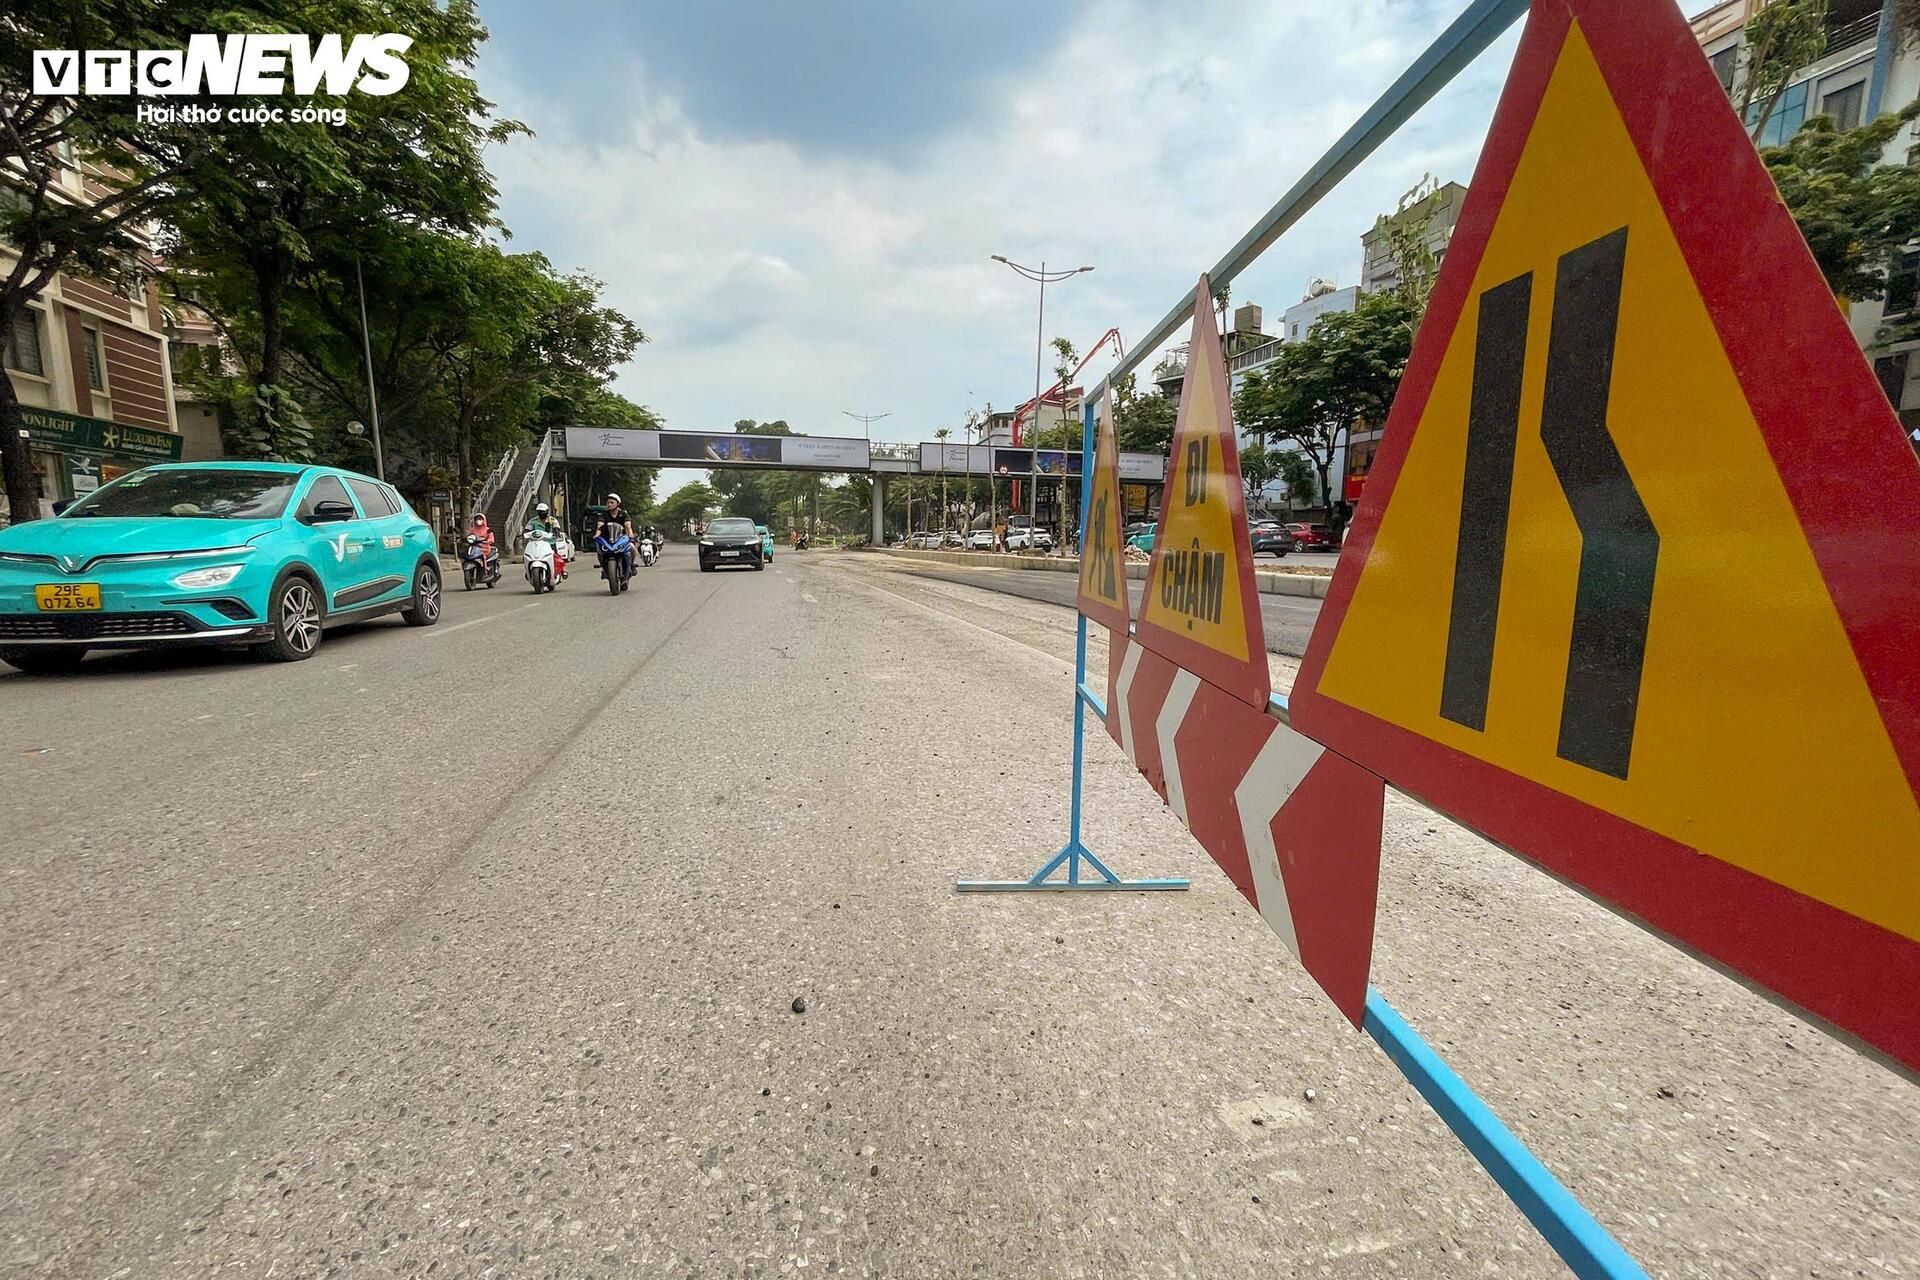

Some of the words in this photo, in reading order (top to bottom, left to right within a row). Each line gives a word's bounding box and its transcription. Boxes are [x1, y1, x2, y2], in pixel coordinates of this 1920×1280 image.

[1185, 435, 1209, 507] ĐI
[44, 597, 95, 609] 072.64
[54, 585, 81, 596] 29E
[1161, 537, 1225, 631] CHẬM
